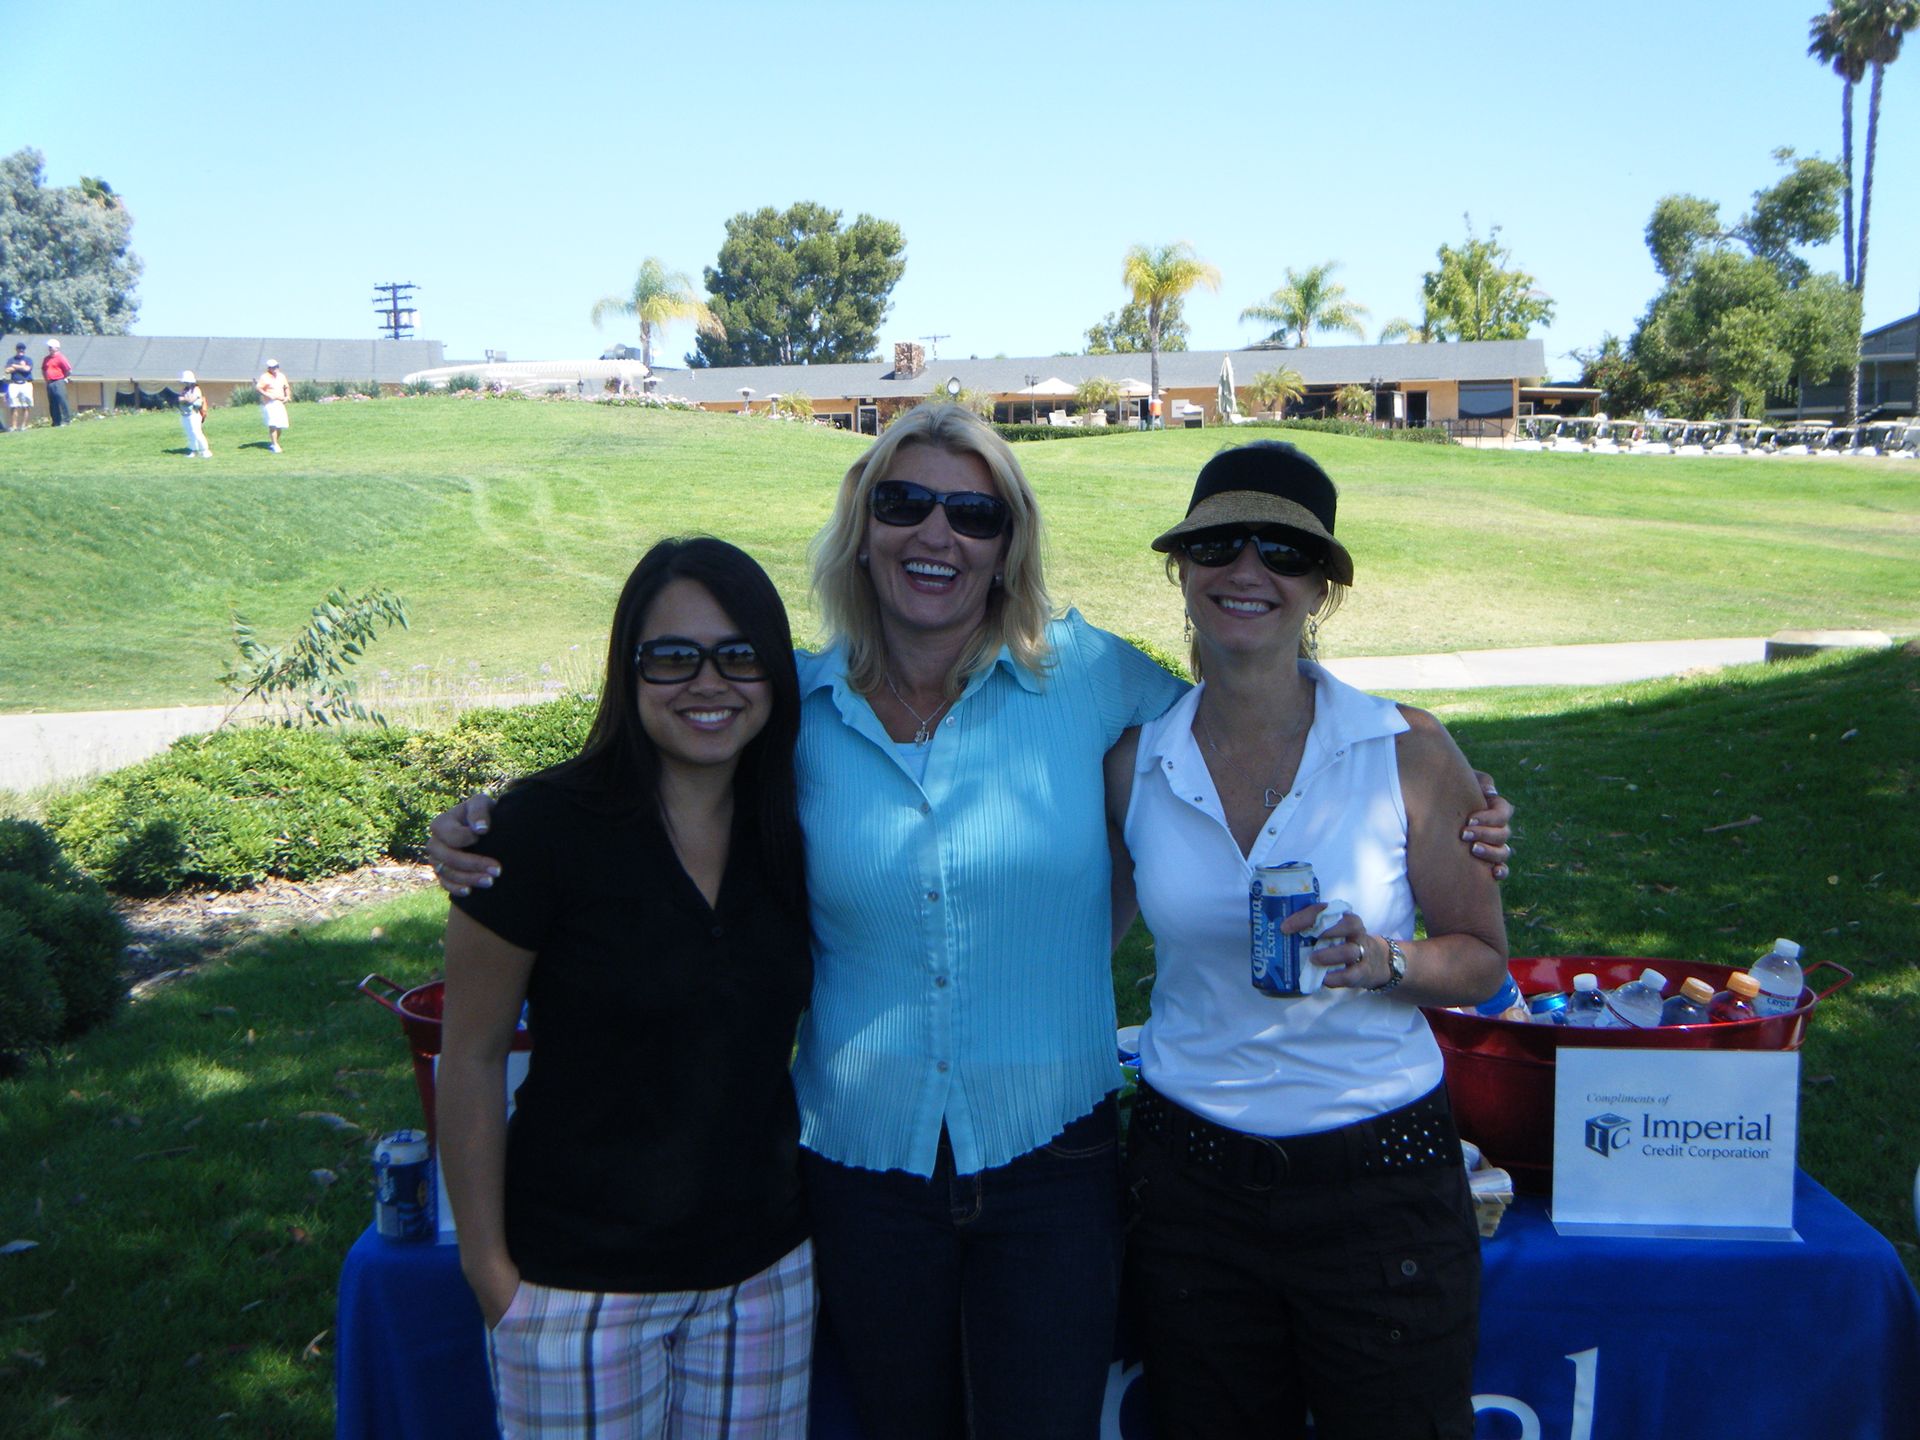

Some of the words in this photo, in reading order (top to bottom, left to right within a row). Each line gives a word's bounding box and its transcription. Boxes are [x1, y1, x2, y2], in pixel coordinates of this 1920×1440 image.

[1252, 898, 1268, 979] Corona
[1264, 922, 1276, 957] Extra
[1586, 1093, 1655, 1105] Compliments
[1657, 1094, 1671, 1106] of
[1642, 1113, 1771, 1143] Imperial
[1642, 1144, 1684, 1156] Credit
[1687, 1145, 1771, 1159] Corporation
